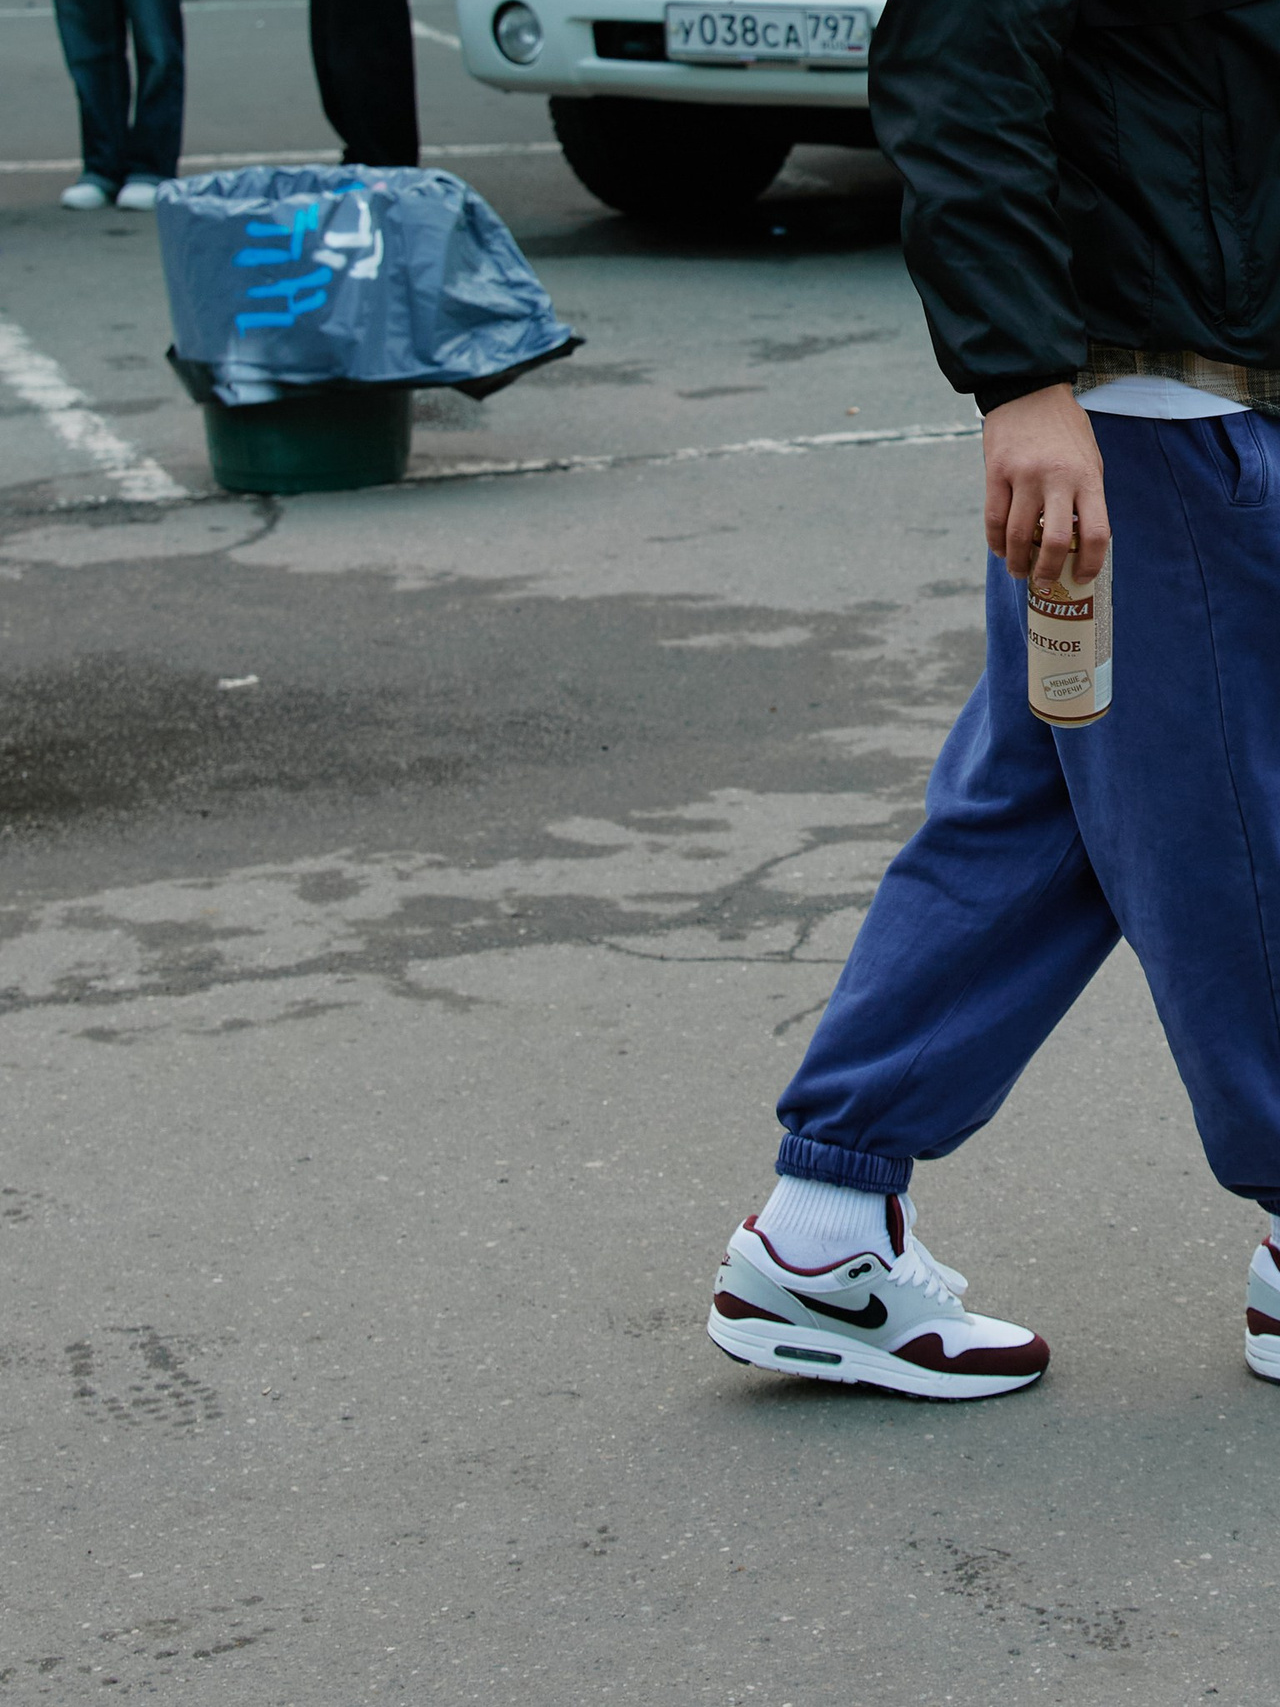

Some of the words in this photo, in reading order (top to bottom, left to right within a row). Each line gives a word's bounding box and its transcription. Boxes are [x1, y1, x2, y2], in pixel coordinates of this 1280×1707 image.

[808, 14, 855, 41] 797
[1028, 591, 1089, 616] АЛТИКА
[1049, 675, 1080, 688] МЕНЬШЕ
[1053, 685, 1083, 697] ГОРЕЧИ
